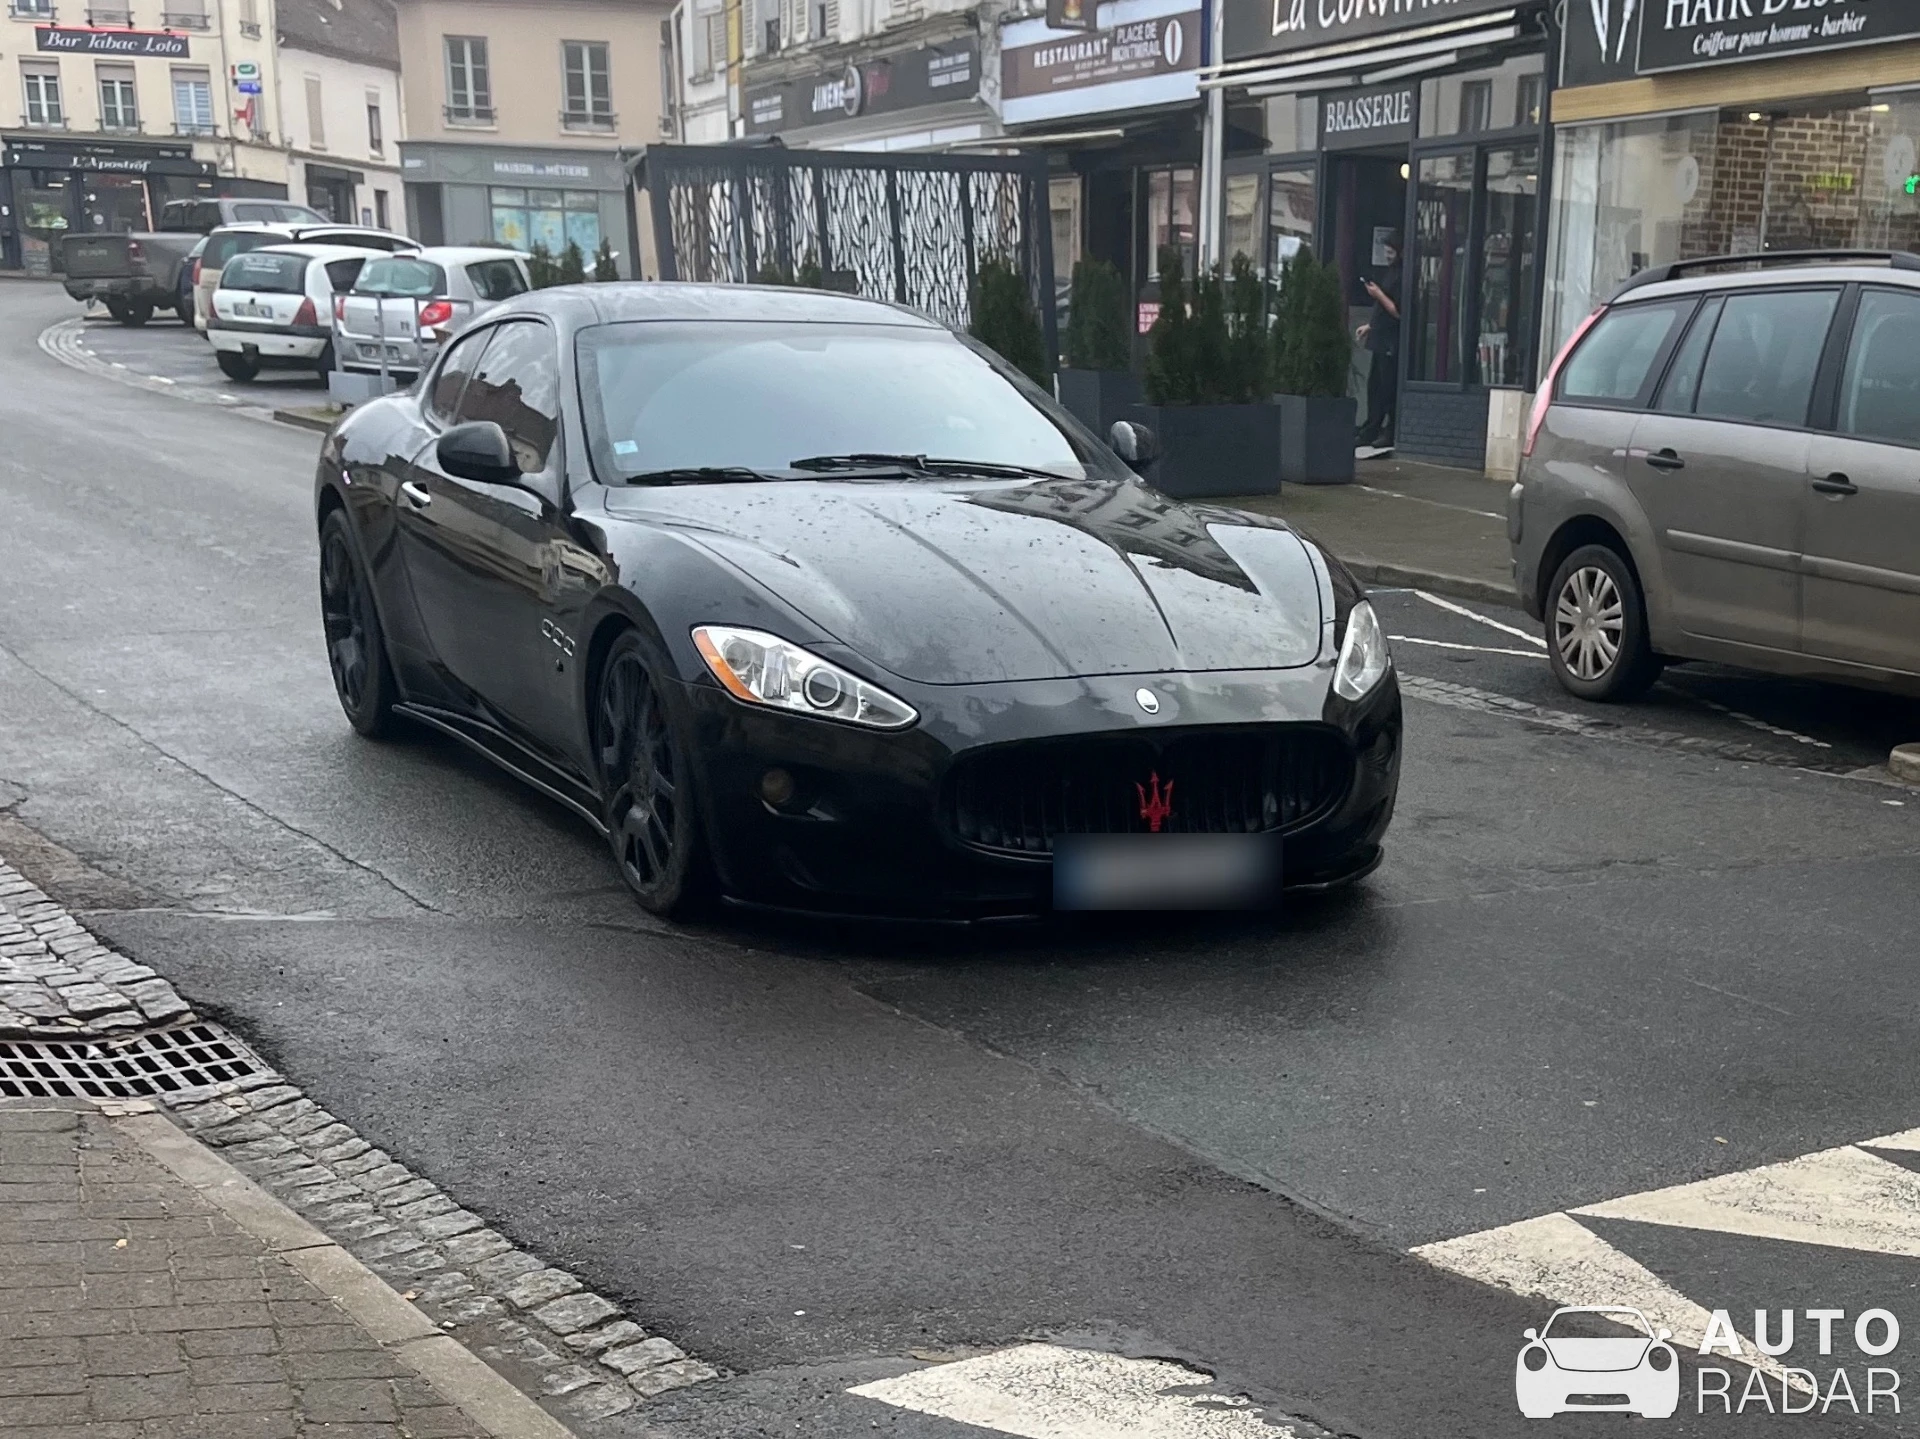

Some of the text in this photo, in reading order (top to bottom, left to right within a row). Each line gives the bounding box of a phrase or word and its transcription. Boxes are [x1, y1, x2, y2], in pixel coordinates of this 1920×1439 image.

[44, 31, 183, 53] Bar Tabac Loto
[1116, 21, 1157, 45] PLACE DE
[1693, 10, 1867, 57] Coiffeur pour homme barbier
[1033, 37, 1108, 69] RESTAURANT
[1325, 90, 1411, 133] BRASSERIE
